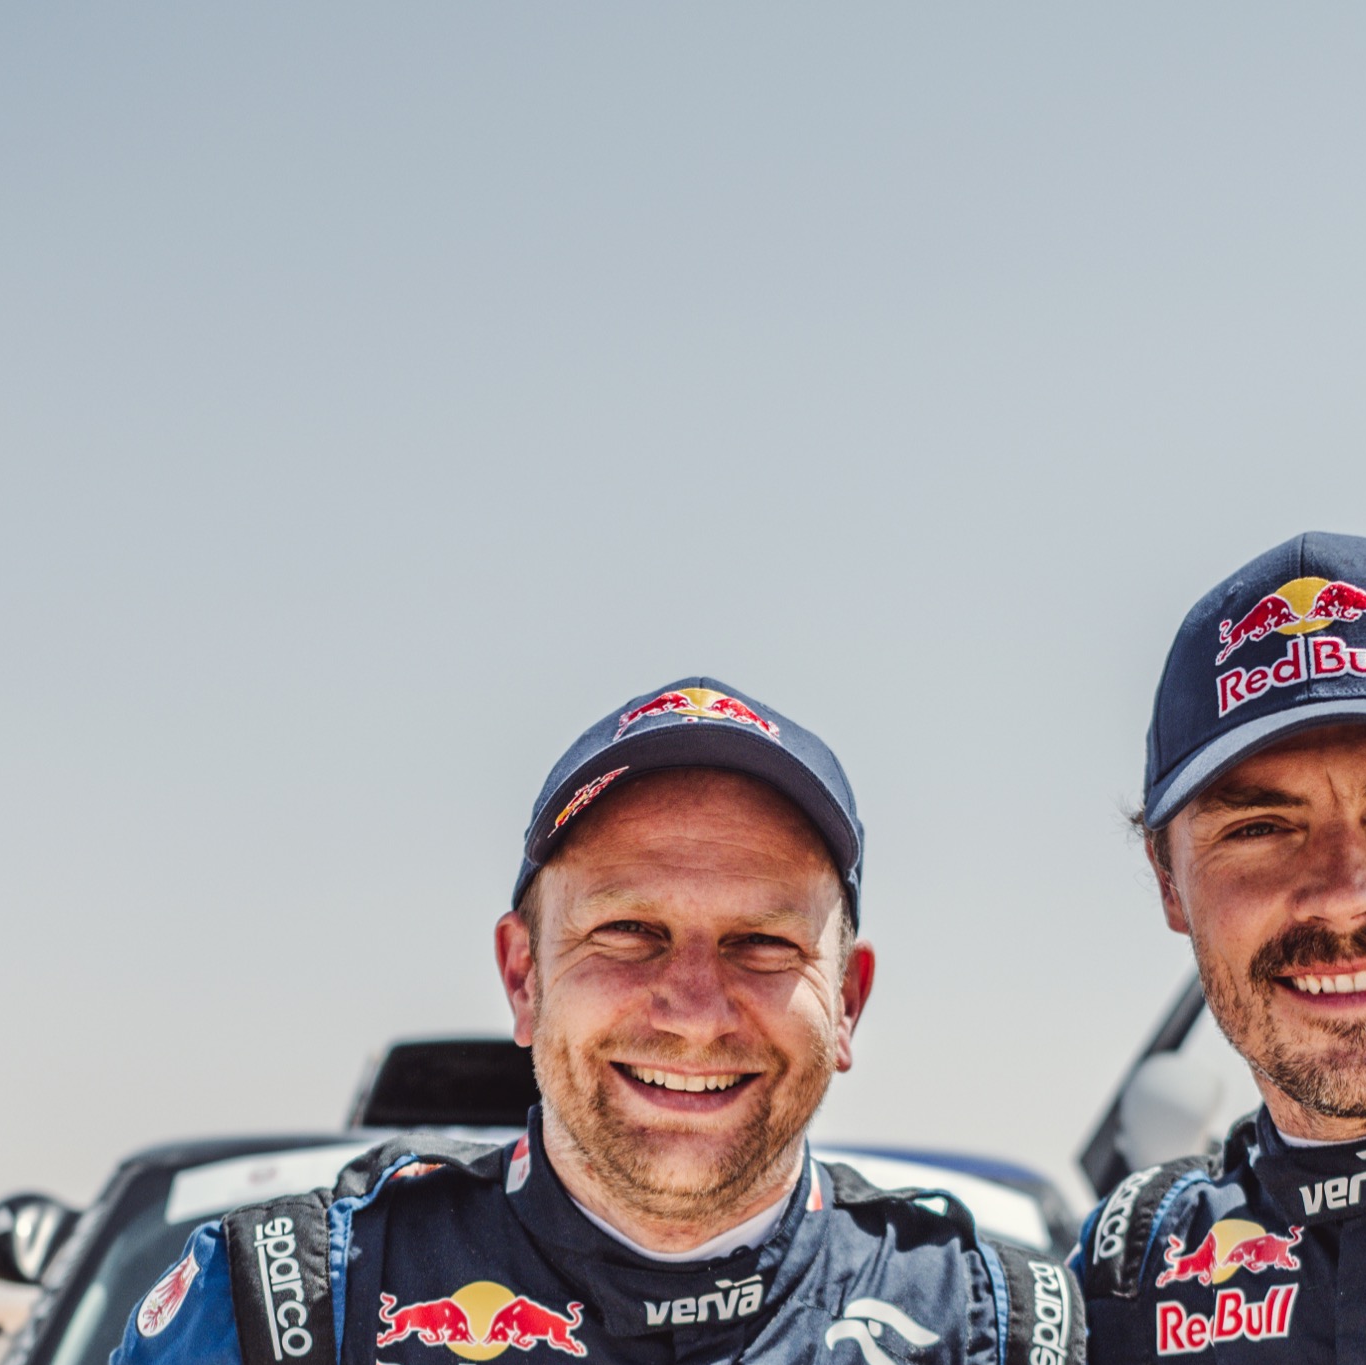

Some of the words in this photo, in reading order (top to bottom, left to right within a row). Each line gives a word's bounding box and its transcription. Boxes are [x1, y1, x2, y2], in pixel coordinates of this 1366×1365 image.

[1217, 636, 1305, 716] Red
[254, 1216, 313, 1361] sparco
[644, 1280, 763, 1326] verva
[1214, 1283, 1299, 1342] Bull
